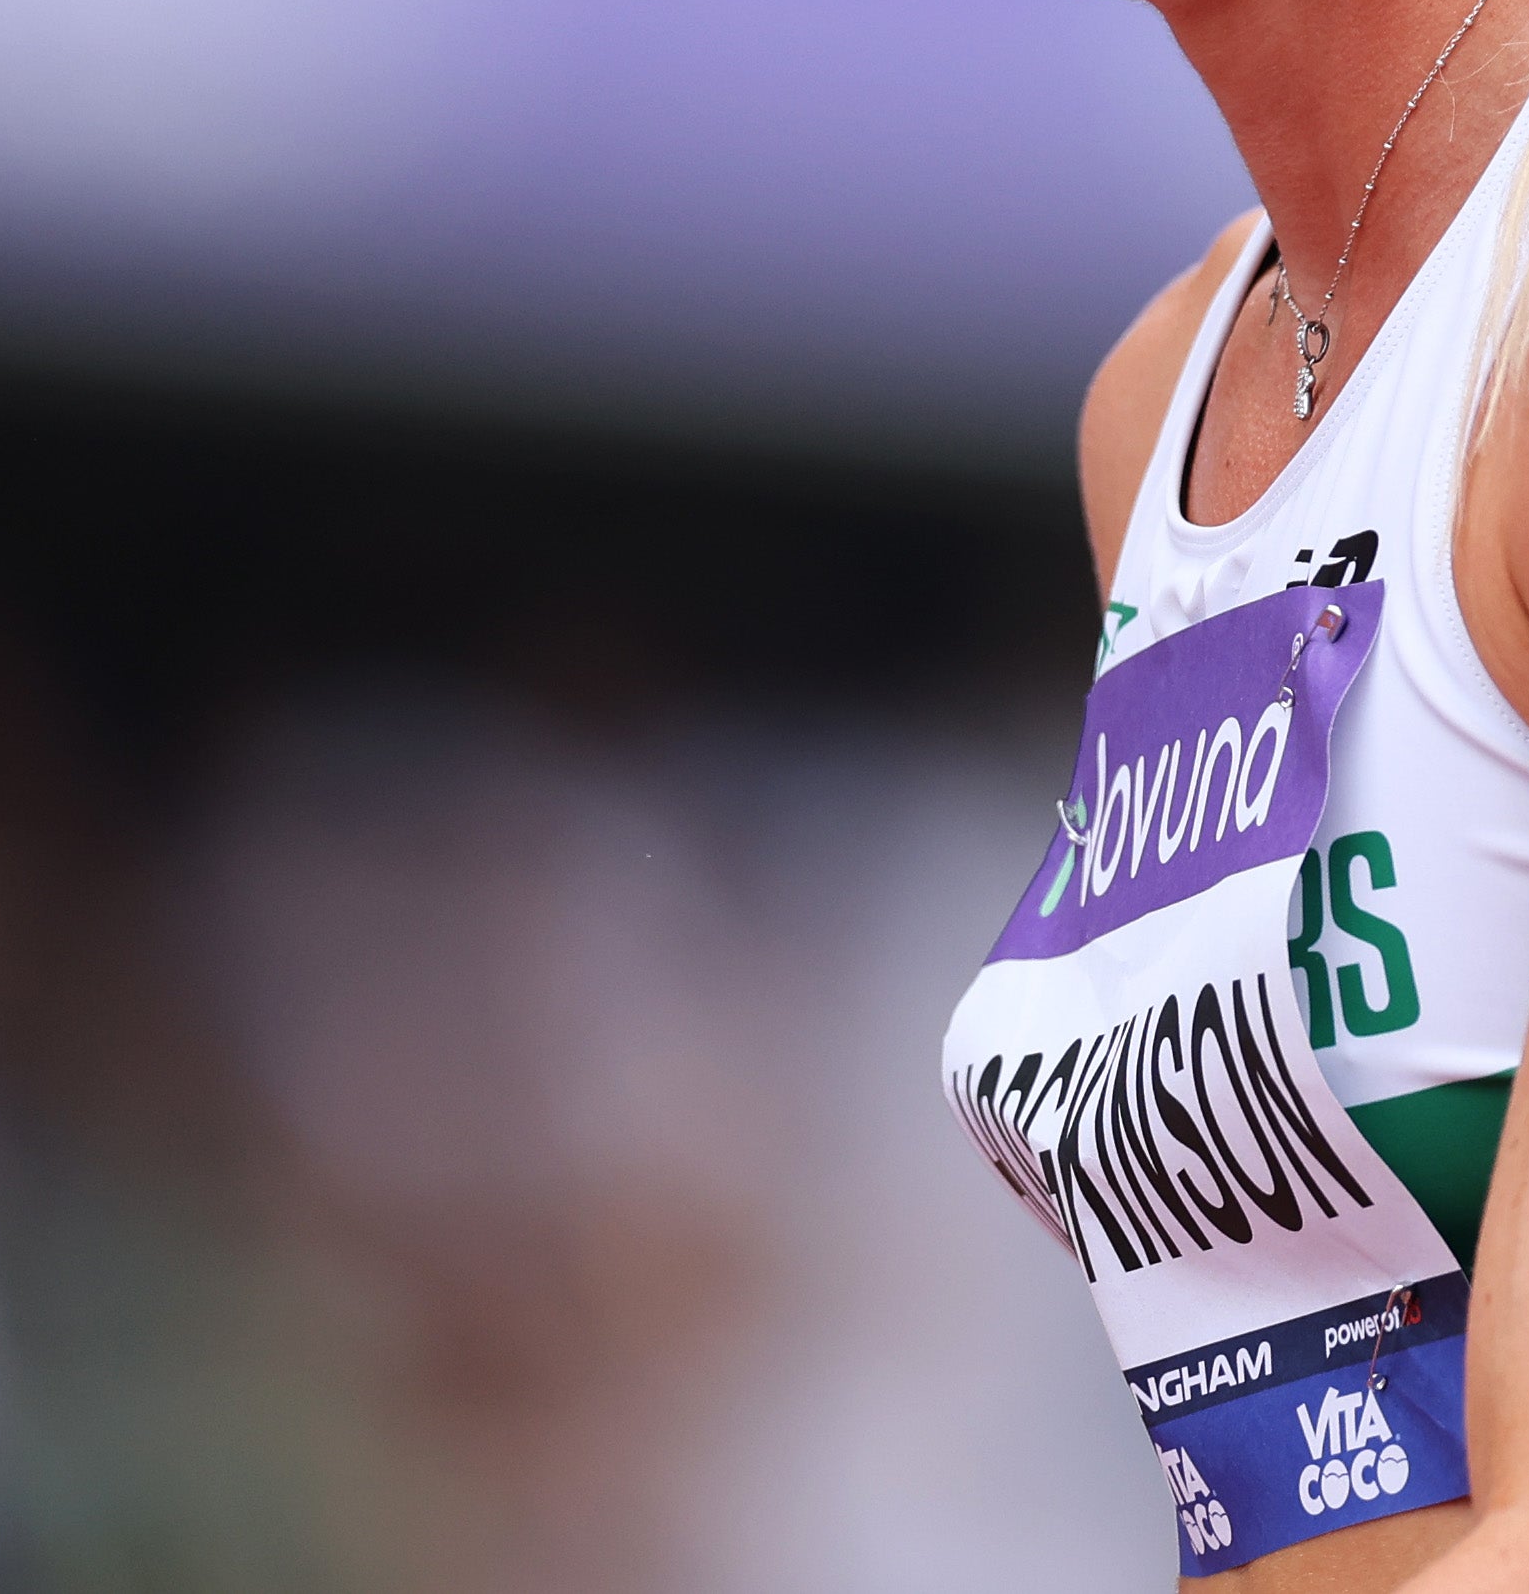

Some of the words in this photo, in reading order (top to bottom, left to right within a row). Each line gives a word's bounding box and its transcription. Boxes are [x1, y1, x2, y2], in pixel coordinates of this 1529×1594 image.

[1296, 1386, 1393, 1460] VITA
[1154, 1442, 1211, 1507] ITA
[1298, 1444, 1410, 1516] COCO
[1180, 1499, 1233, 1556] OCO
